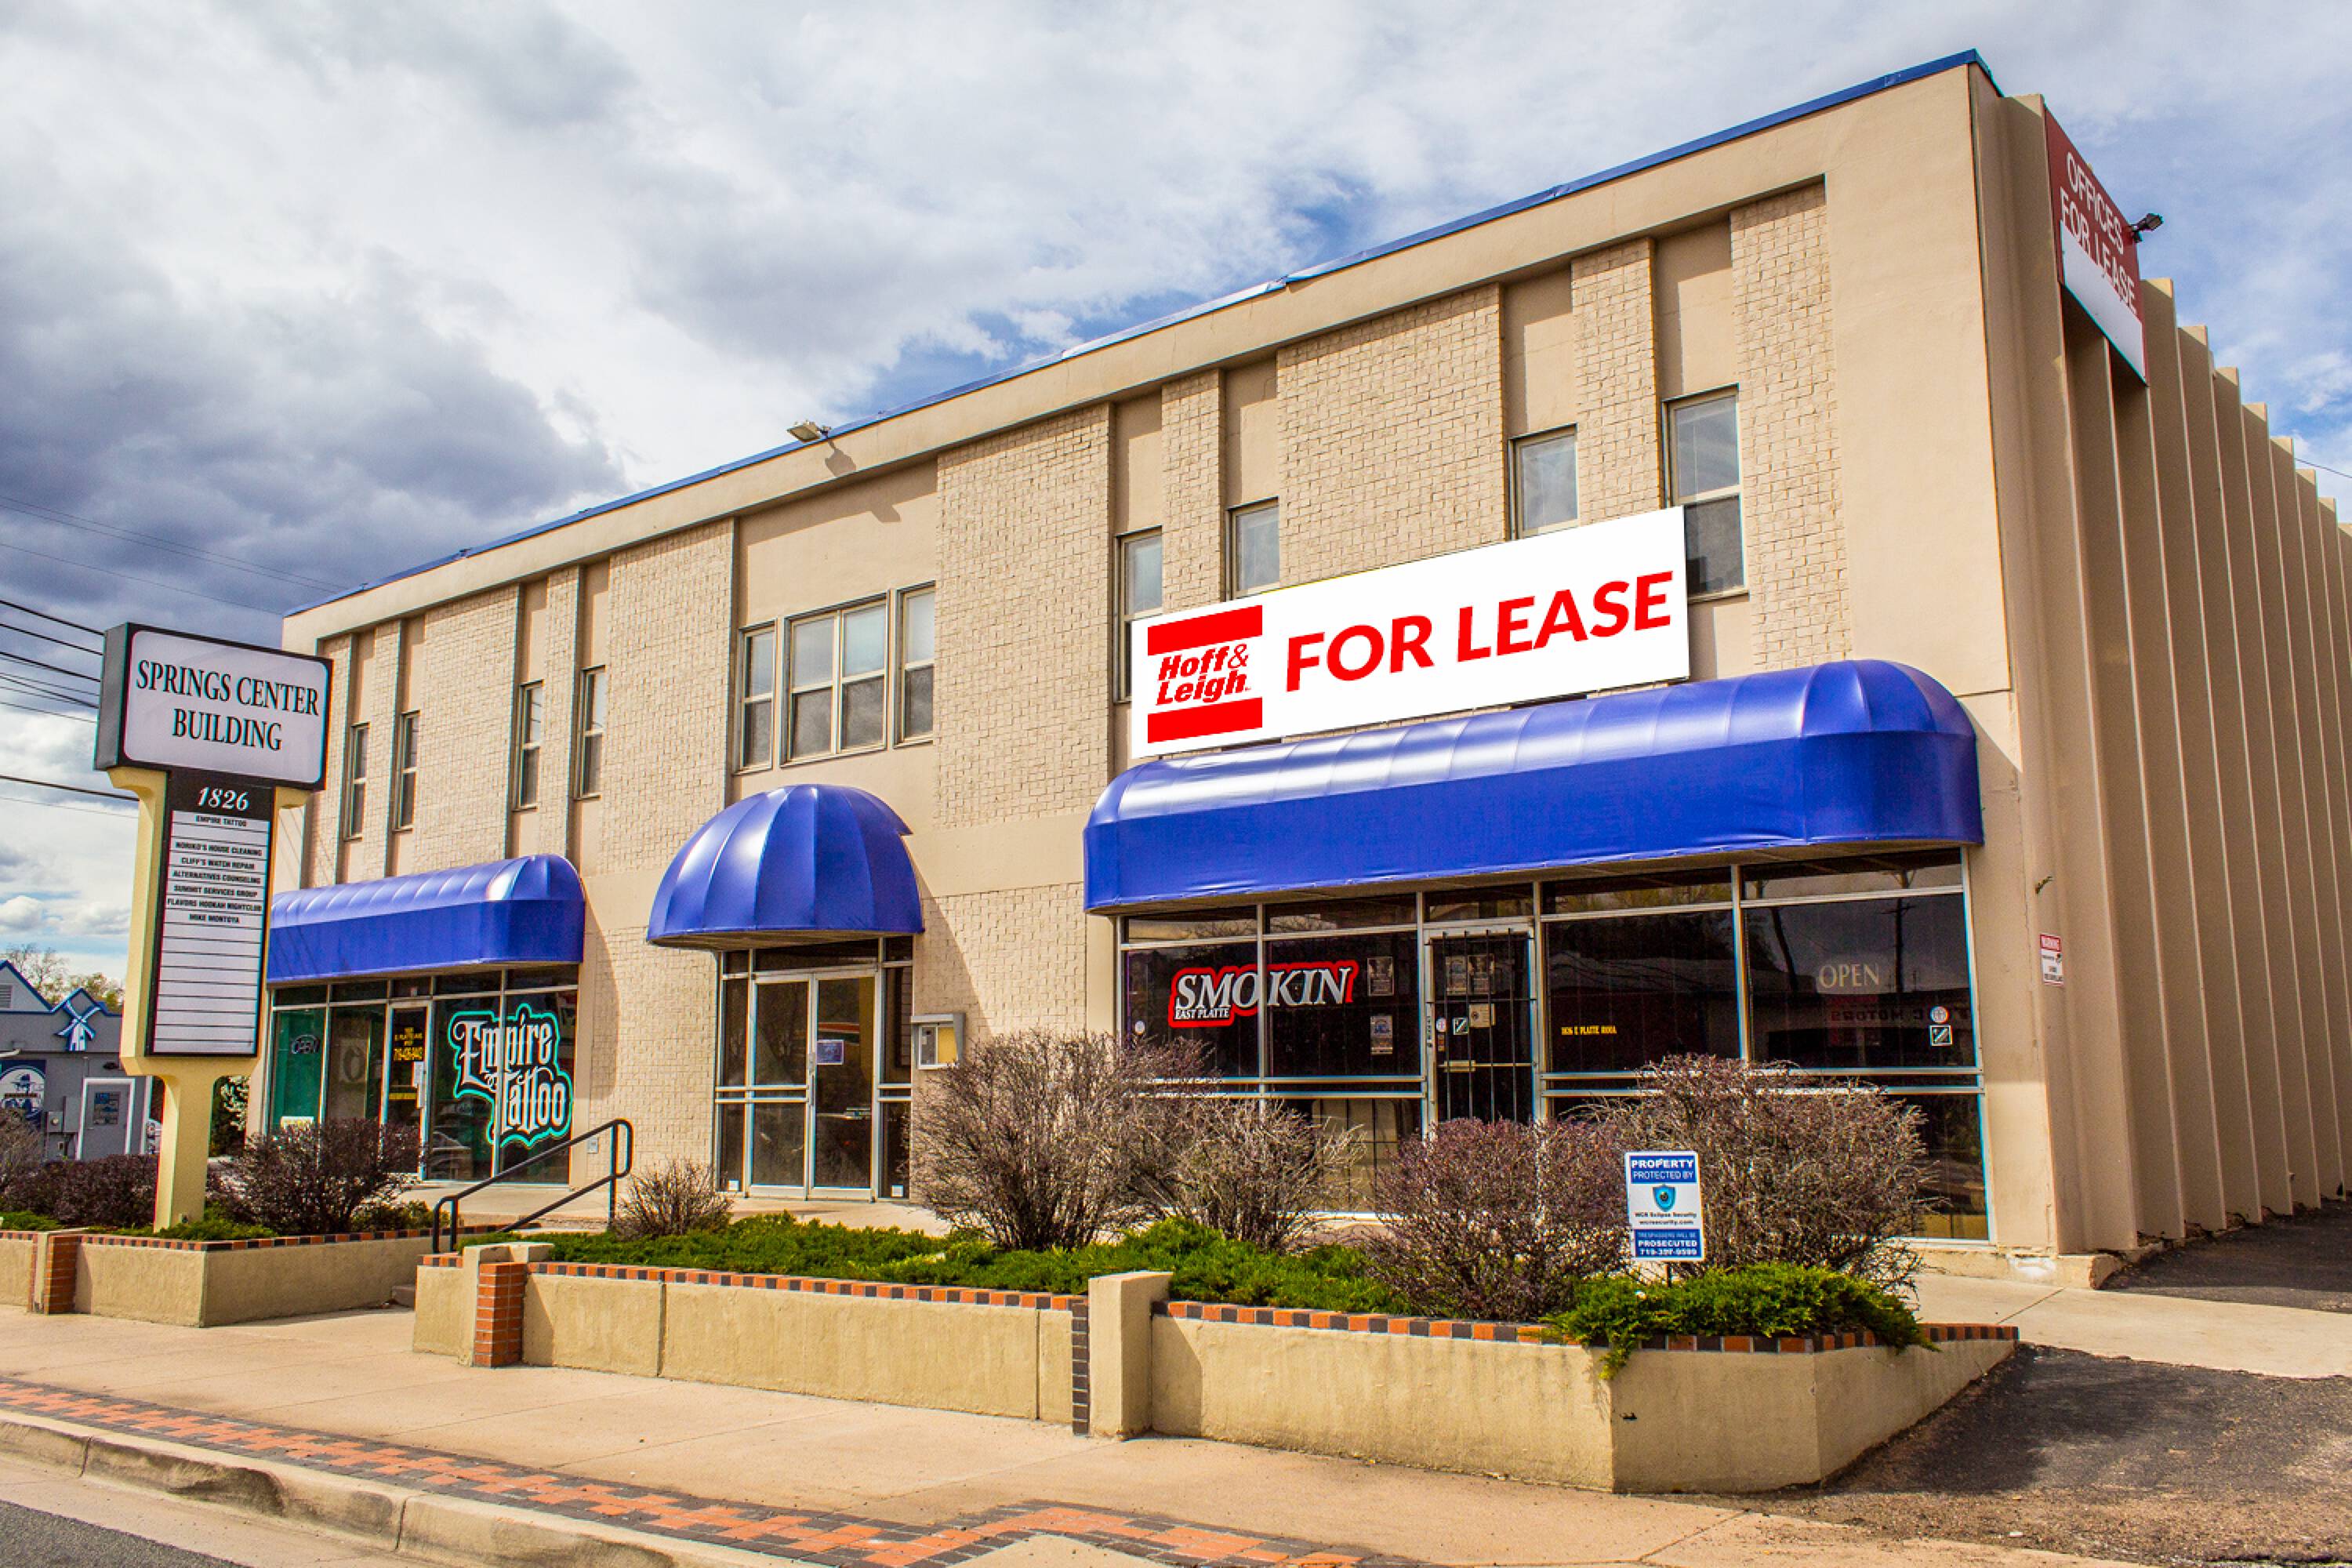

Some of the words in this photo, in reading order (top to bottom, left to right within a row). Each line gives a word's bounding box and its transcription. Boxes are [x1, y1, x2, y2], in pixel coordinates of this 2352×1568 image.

[2067, 151, 2124, 256] OFFICES
[2060, 187, 2091, 259] FOR
[1286, 615, 1435, 692] FOR
[1457, 571, 1674, 662] LEASE
[136, 659, 231, 702] SPRINGS
[237, 677, 319, 716] CENTER
[172, 708, 282, 751] BUILDING
[198, 786, 250, 811] 1826
[195, 815, 221, 825] EMPIRE
[223, 818, 247, 827] TATTOO
[231, 847, 262, 856] CLEANING
[173, 869, 221, 880] ALTERNATIVES
[222, 874, 260, 884] COUNSELING
[1176, 967, 1353, 1010] SMOKIN
[1819, 962, 1880, 989] OPEN
[1174, 1007, 1196, 1019] EAST
[1198, 1007, 1231, 1019] PLATTE
[453, 1014, 553, 1092] Empire
[485, 1066, 566, 1135] Tattoo
[1632, 1159, 1693, 1168] PROPERTY
[1633, 1171, 1682, 1180] PROTECTED
[1682, 1171, 1693, 1180] BY
